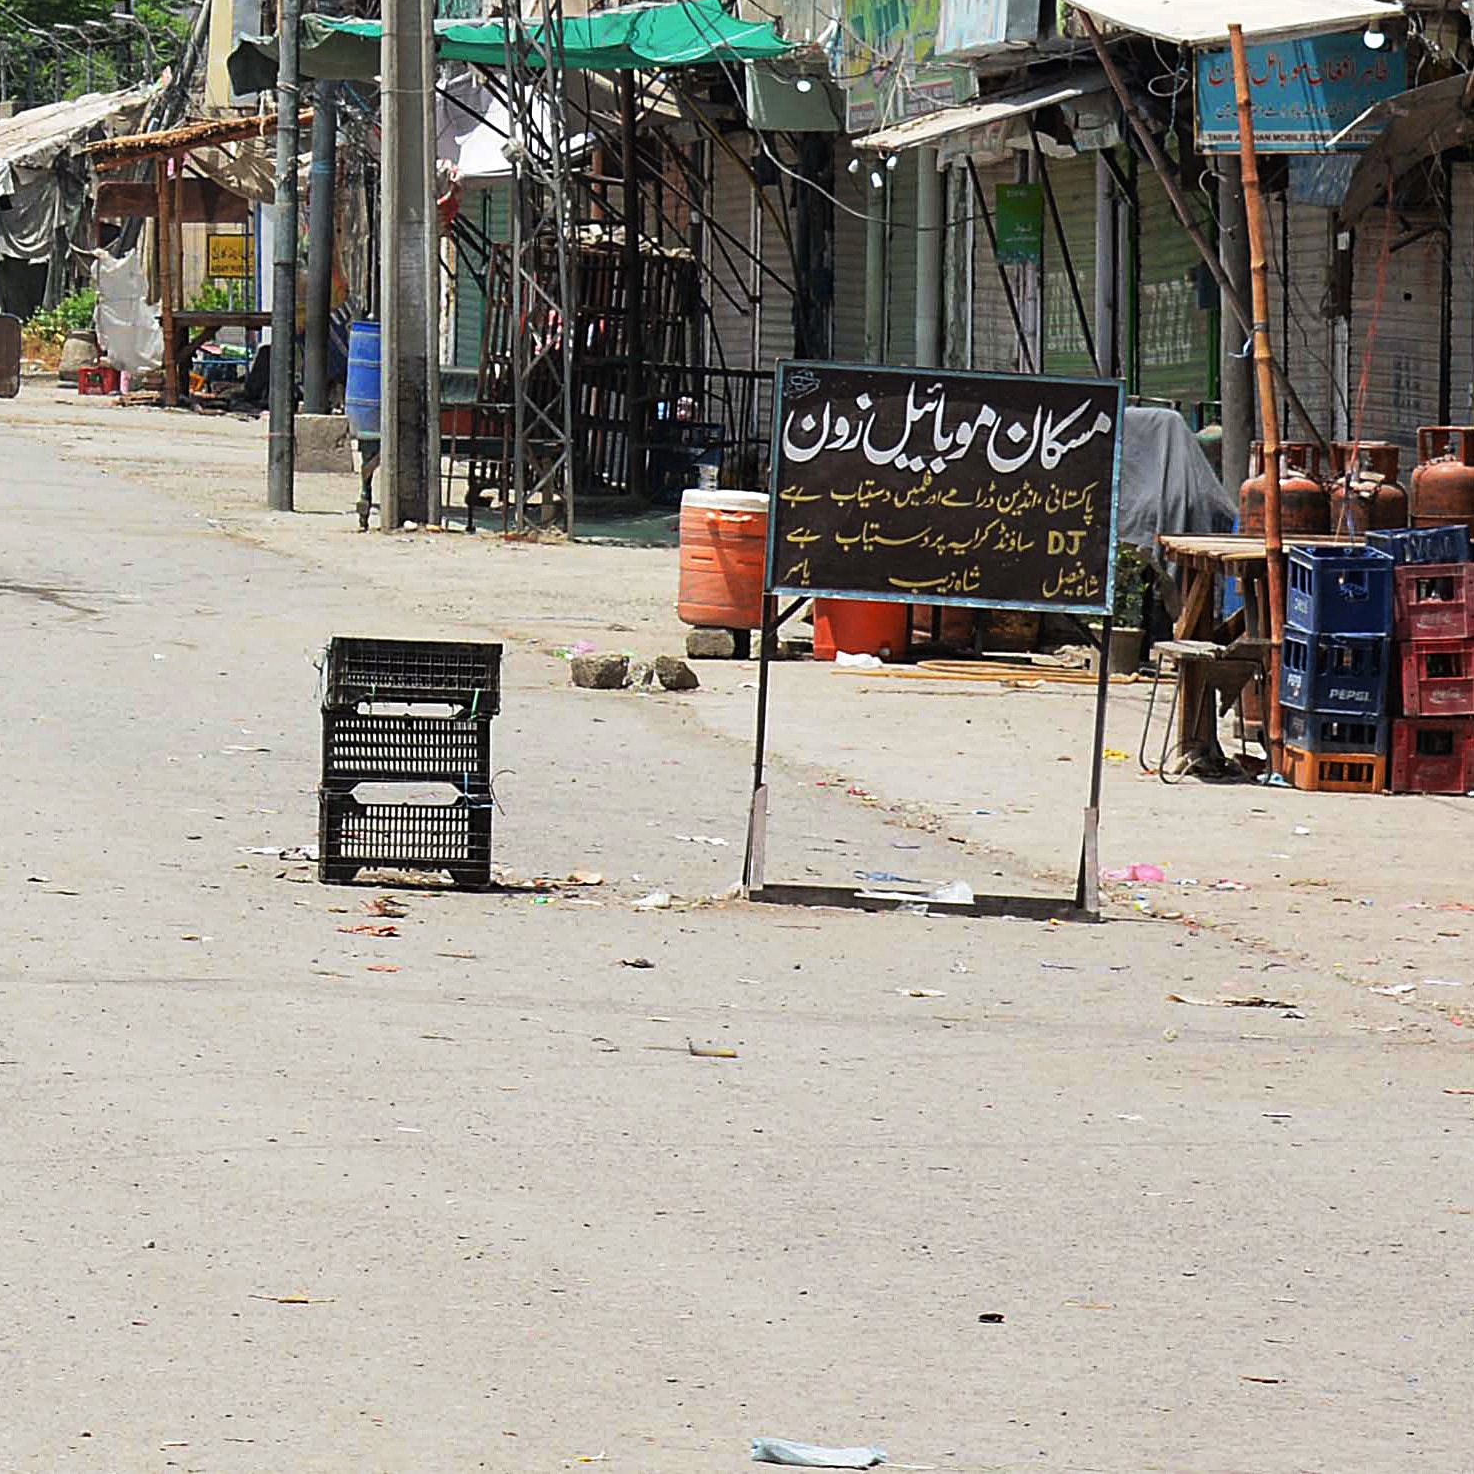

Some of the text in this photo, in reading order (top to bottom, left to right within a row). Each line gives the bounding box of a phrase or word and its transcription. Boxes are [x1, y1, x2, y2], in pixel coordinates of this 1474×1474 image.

[783, 393, 872, 462] زون
[863, 381, 997, 474] موبائل
[987, 399, 1111, 473] مسکان
[830, 480, 891, 507] دستیاب
[893, 469, 932, 508] فلمیں
[924, 491, 942, 505] اور
[941, 481, 996, 508] ڈرامے
[835, 521, 931, 552] دستیاب
[928, 534, 944, 556] پر
[947, 519, 1000, 555] کرایہ
[1047, 530, 1086, 555] DJ
[783, 558, 811, 586] یاسر
[1329, 688, 1371, 702] PEPSI
